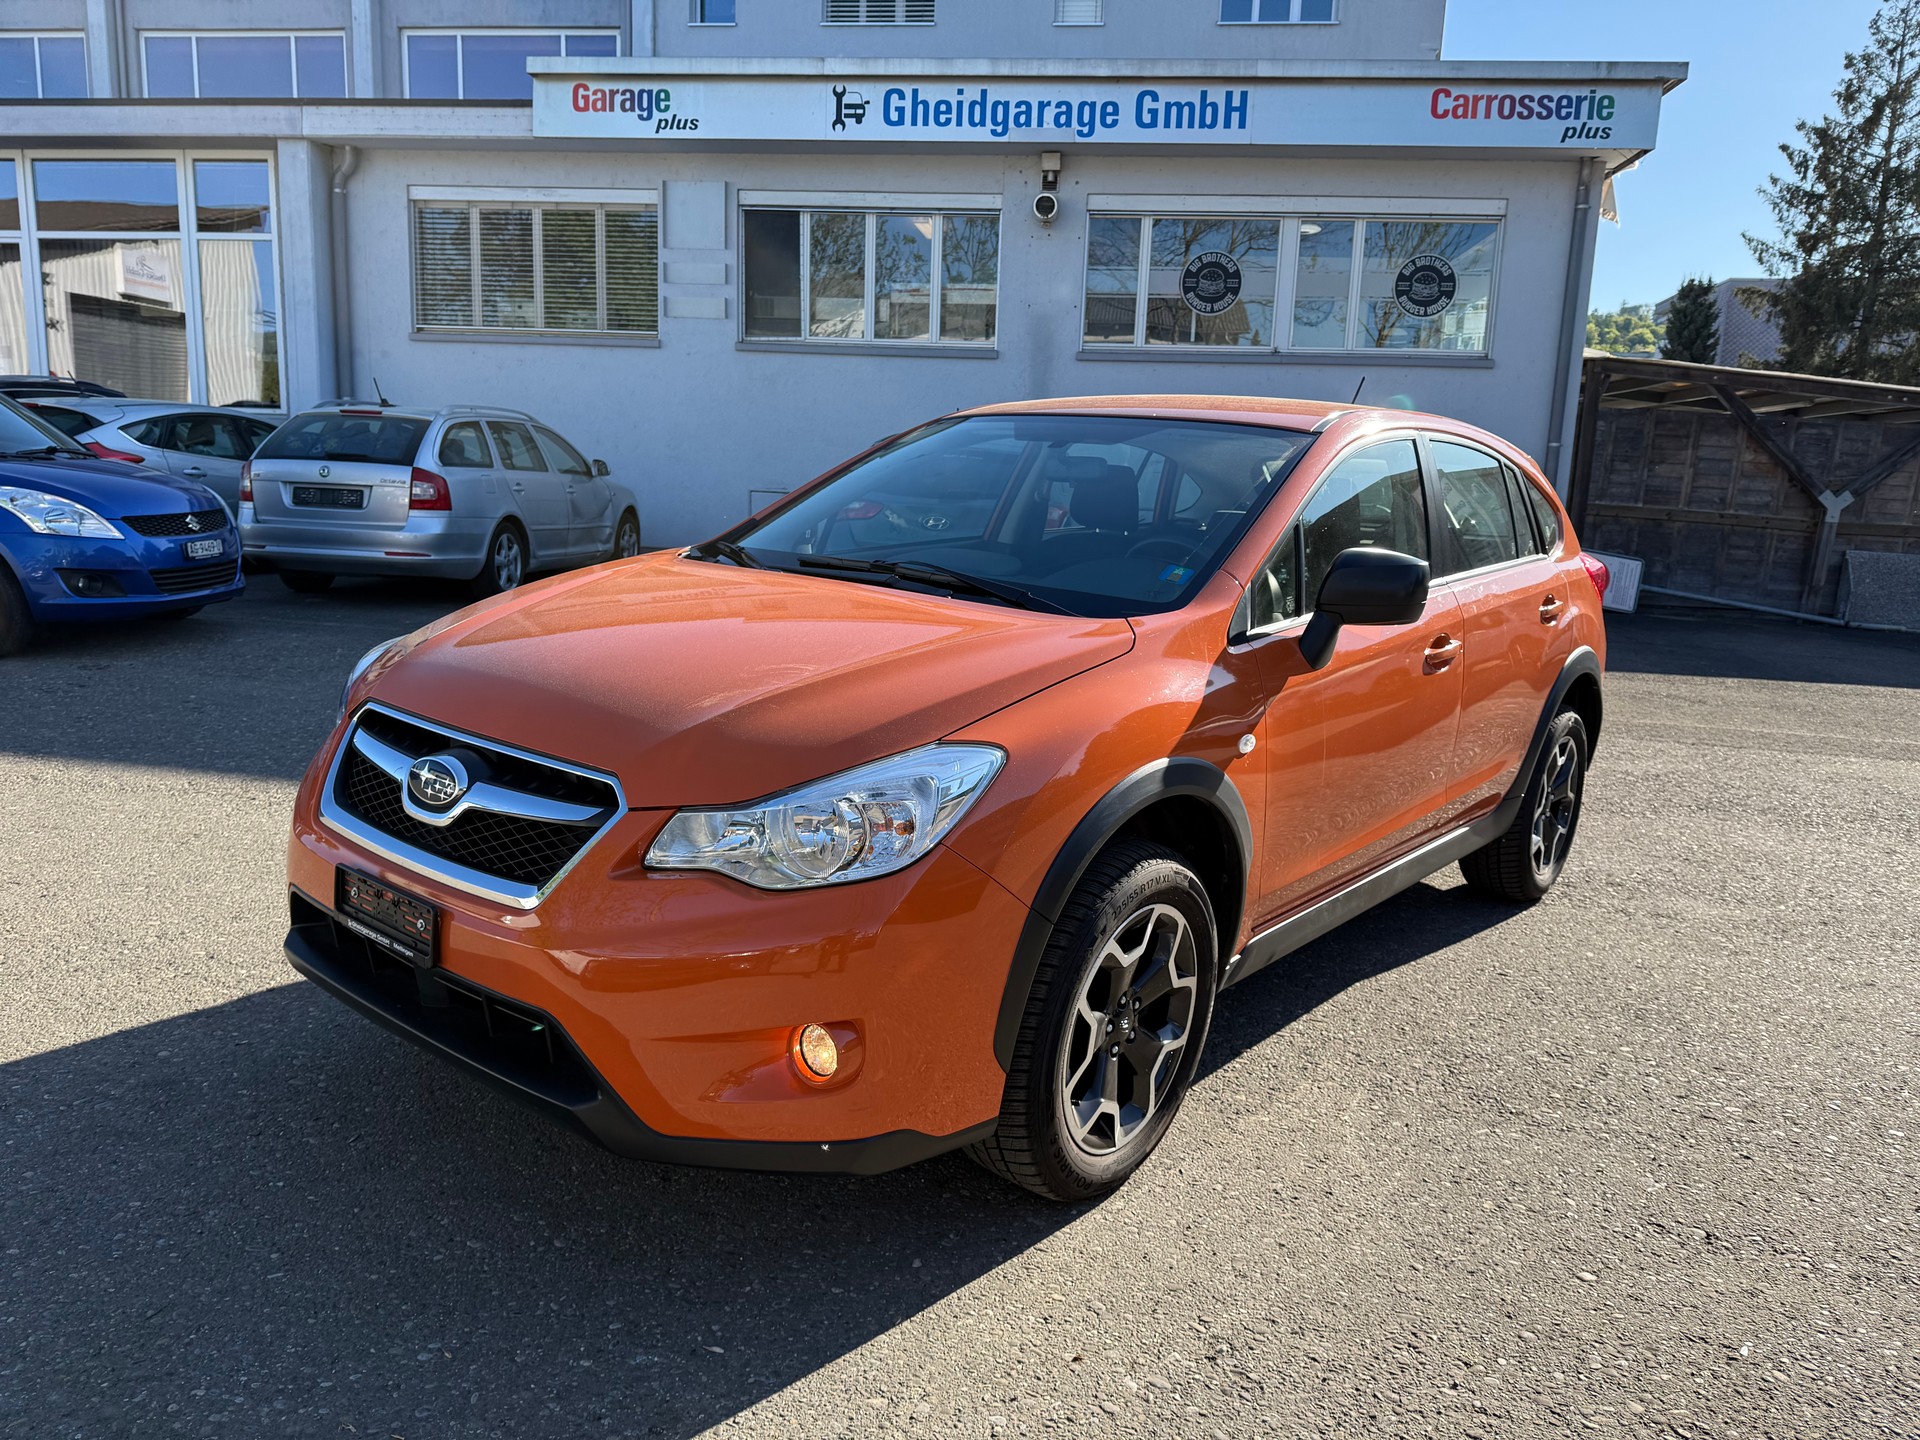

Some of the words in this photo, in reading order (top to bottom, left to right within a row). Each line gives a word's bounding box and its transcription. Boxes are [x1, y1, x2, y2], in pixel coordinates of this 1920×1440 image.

[572, 82, 671, 121] Garage
[1430, 87, 1615, 121] Carrosserie
[655, 114, 700, 134] plus
[882, 88, 1120, 138] Gheidgarage
[1135, 89, 1249, 130] GmbH
[1560, 121, 1613, 143] plus
[1188, 259, 1202, 273] BIG
[1201, 253, 1238, 273] BROTHERS
[1401, 262, 1416, 277] BIG
[1415, 256, 1452, 277] BROTHERS
[1185, 291, 1212, 312] BURGER
[1212, 292, 1236, 312] HOUSE
[1398, 295, 1425, 316] BURGER
[1426, 295, 1451, 315] HOUSE
[1111, 888, 1139, 921] 225/55
[1140, 877, 1154, 894] R17
[1162, 873, 1172, 883] XL
[1053, 1146, 1094, 1192] POLARIS
